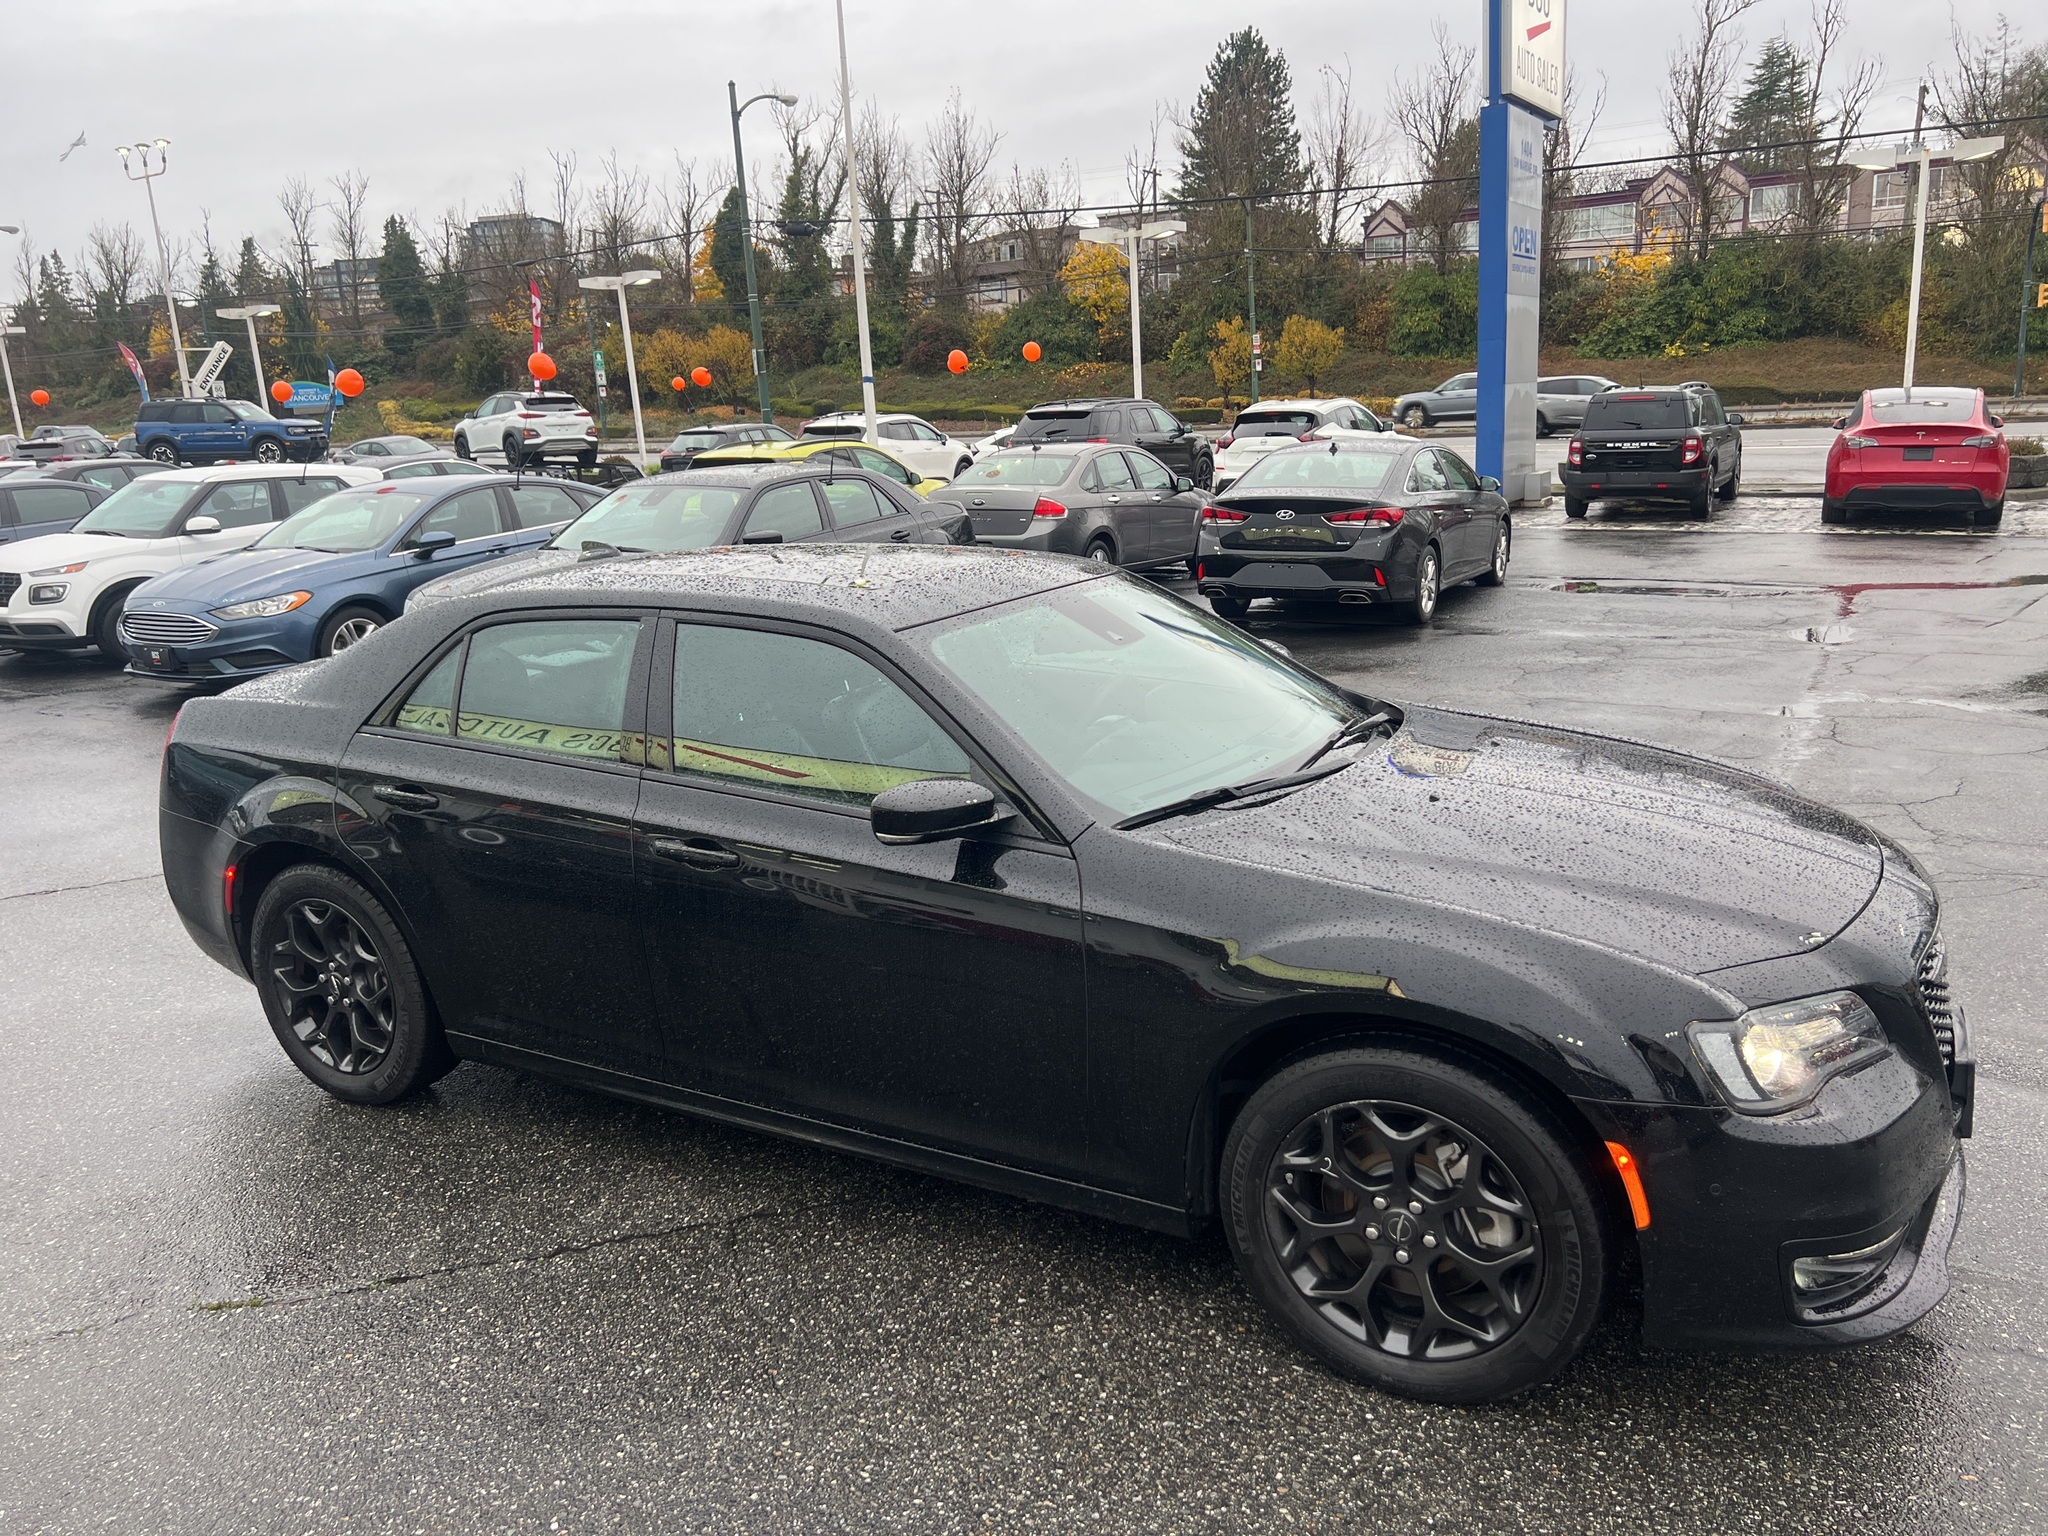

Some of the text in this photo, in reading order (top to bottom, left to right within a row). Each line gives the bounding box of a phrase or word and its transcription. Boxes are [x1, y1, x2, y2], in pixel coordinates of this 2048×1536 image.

[1516, 45, 1559, 96] AUTO SALES
[1513, 225, 1537, 255] OPEN
[199, 347, 229, 391] ENTRANCE
[289, 393, 331, 402] VANCOUVE
[1231, 1137, 1254, 1230] MICHELIN
[1552, 1239, 1582, 1338] MICHELIN
